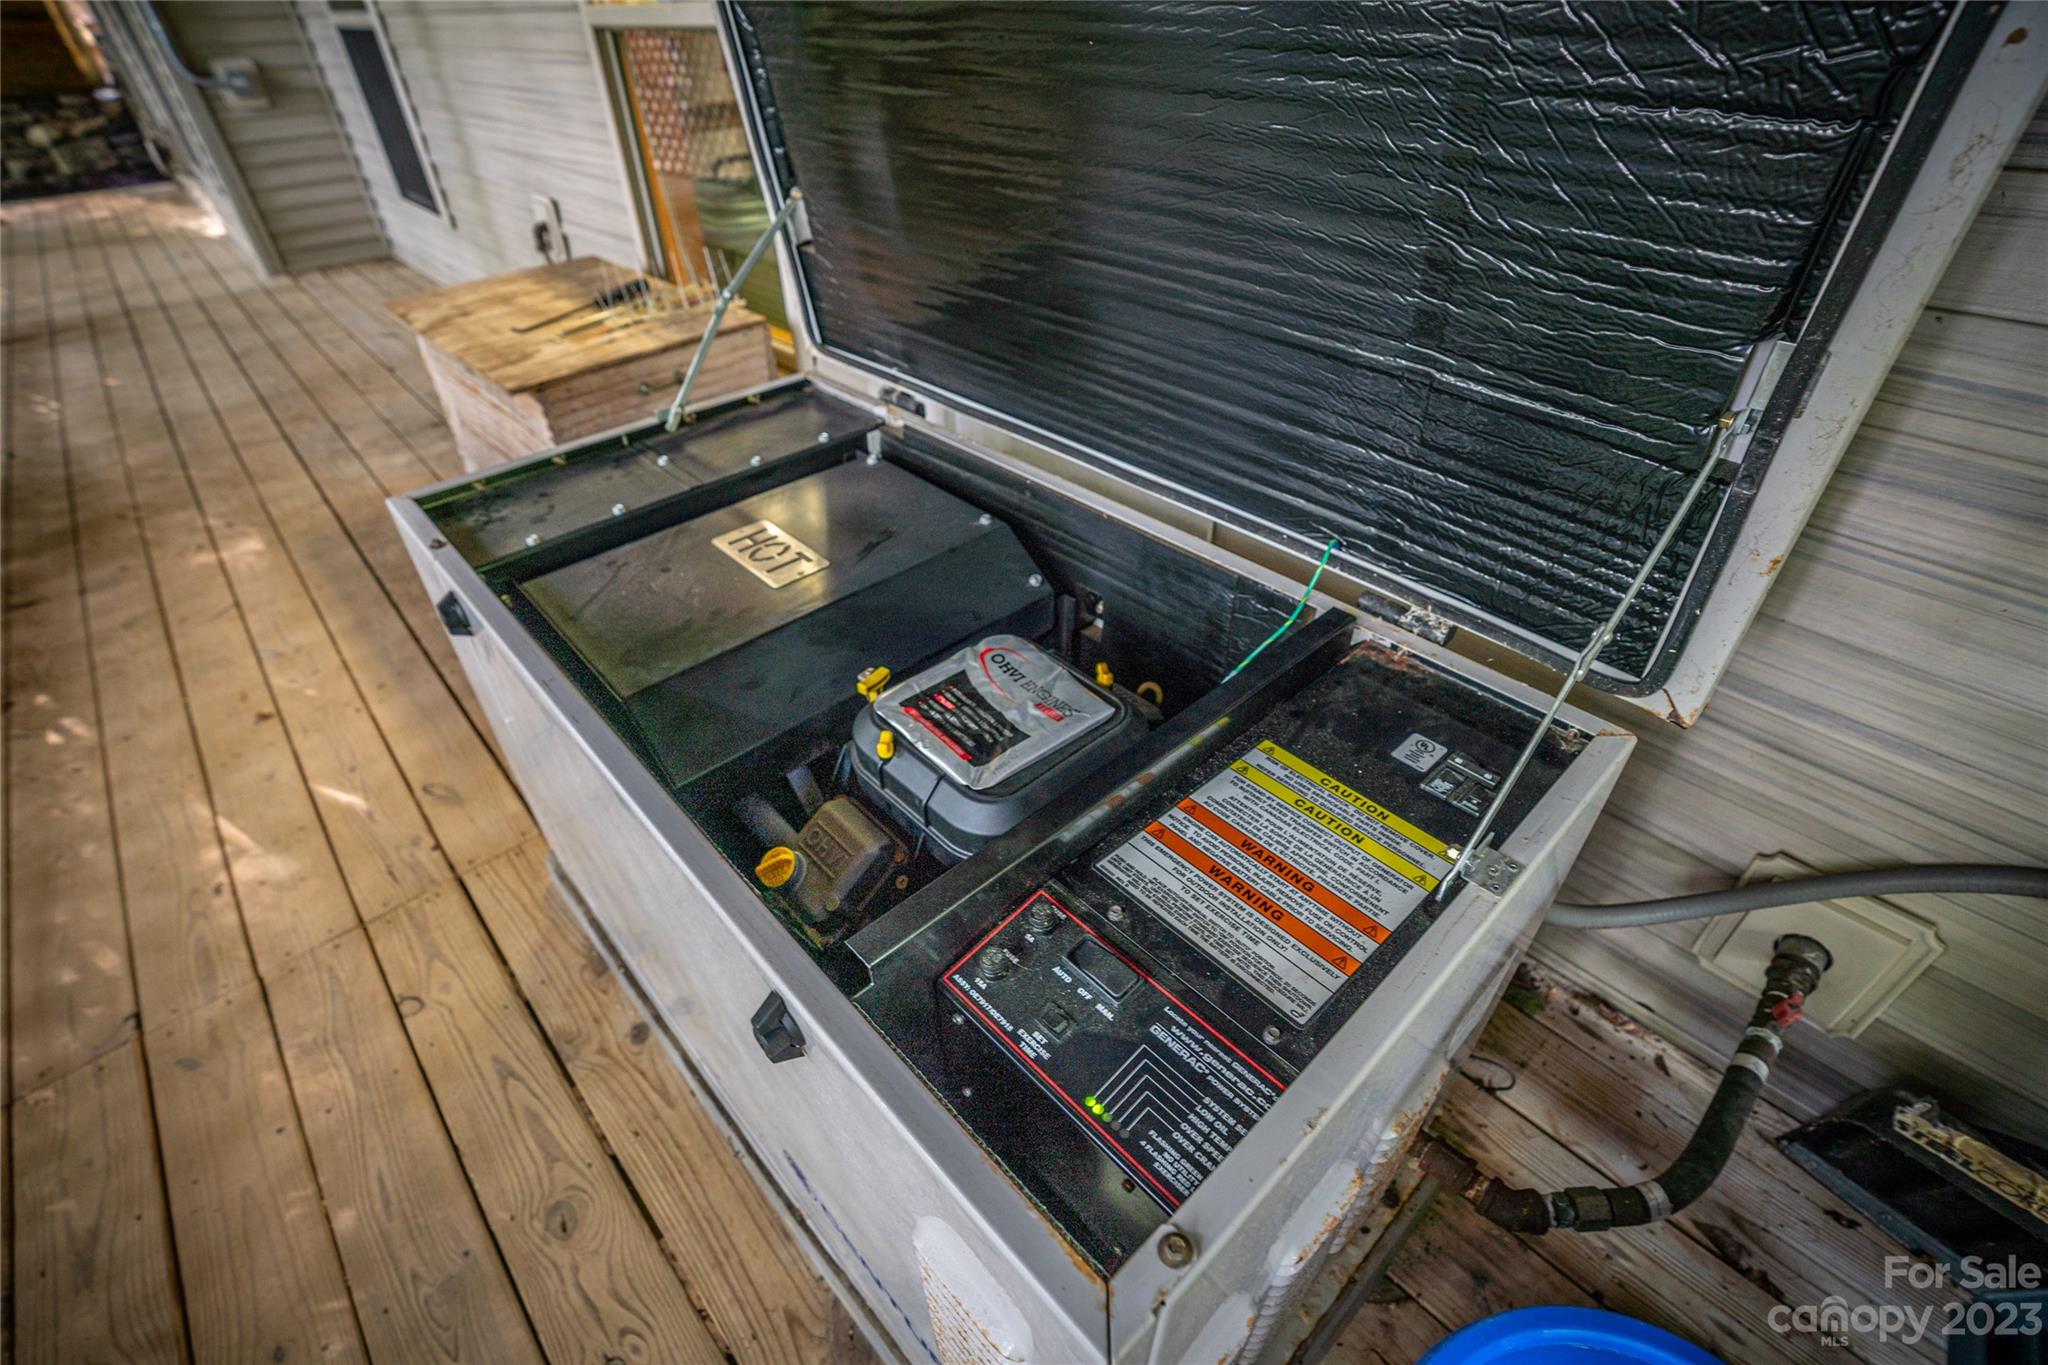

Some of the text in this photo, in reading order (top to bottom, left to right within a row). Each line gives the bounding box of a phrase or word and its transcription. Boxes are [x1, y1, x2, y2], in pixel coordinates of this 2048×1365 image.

[728, 527, 814, 574] HOT
[991, 653, 1027, 682] OHVI
[1020, 680, 1074, 717] ENGINES
[1292, 797, 1365, 844] CAUTION
[1318, 777, 1390, 820] CAUTION
[1242, 794, 1260, 806] WITH
[1258, 805, 1292, 827] CANADIAN
[1291, 826, 1332, 853] ELECTRICAL
[1332, 852, 1355, 868] CODE,
[1355, 866, 1375, 880] PART
[1167, 813, 1191, 830] NOTICE.
[1200, 836, 1221, 850] AVOID
[1218, 848, 1252, 872] PERSONAL
[1251, 871, 1277, 889] INJURY
[1275, 887, 1305, 909] REMOVE
[1303, 907, 1323, 921] FUSE
[1333, 927, 1369, 953] CONTROL
[1168, 822, 1188, 836] PANEL
[1200, 844, 1232, 867] NEGATIVE
[1230, 865, 1260, 886] BATTERY
[1258, 884, 1283, 902] CABLE
[1281, 900, 1304, 917] PRIOR
[1313, 922, 1355, 952] SERVICING.
[1238, 839, 1316, 892] WARNING
[1139, 835, 1156, 847] THIS
[1153, 845, 1194, 874] EMERGENCY
[1192, 873, 1219, 892] POWER
[1217, 890, 1247, 912] SYSTEM
[1253, 916, 1291, 945] DESIGNED
[1290, 942, 1340, 980] EXCLUSIVELY
[1184, 876, 1219, 902] OUTDOOR
[1217, 900, 1267, 936] INSTALLATION
[1265, 934, 1288, 952] ONLY!
[1206, 864, 1285, 921] WARNING
[1204, 903, 1241, 932] EXERCISE
[1240, 930, 1261, 946] TIME
[951, 972, 971, 991] ASSY:
[1051, 964, 1073, 984] AUTO
[1076, 986, 1093, 1002] OFF
[1016, 1027, 1051, 1061] EXERCISE
[1018, 1040, 1037, 1059] TIME
[1031, 1029, 1048, 1046] SET
[1163, 1005, 1189, 1028] Locate
[1185, 1025, 1205, 1042] your
[1203, 1038, 1233, 1064] nearest
[1194, 1103, 1230, 1136] LOW OIL
[1202, 1095, 1236, 1126] SYSTEM
[1205, 1074, 1234, 1099] POWER
[1232, 1096, 1261, 1122] SYSTE
[1170, 1129, 1196, 1154] OVER
[1178, 1120, 1225, 1163] OVER SPEE
[1187, 1112, 1211, 1134] HIGH
[1143, 1143, 1178, 1176] FLASHING
[1175, 1172, 1191, 1188] RED
[1147, 1128, 1204, 1181] FLASHING GREEN
[1161, 1150, 1200, 1187] NO UTILITY
